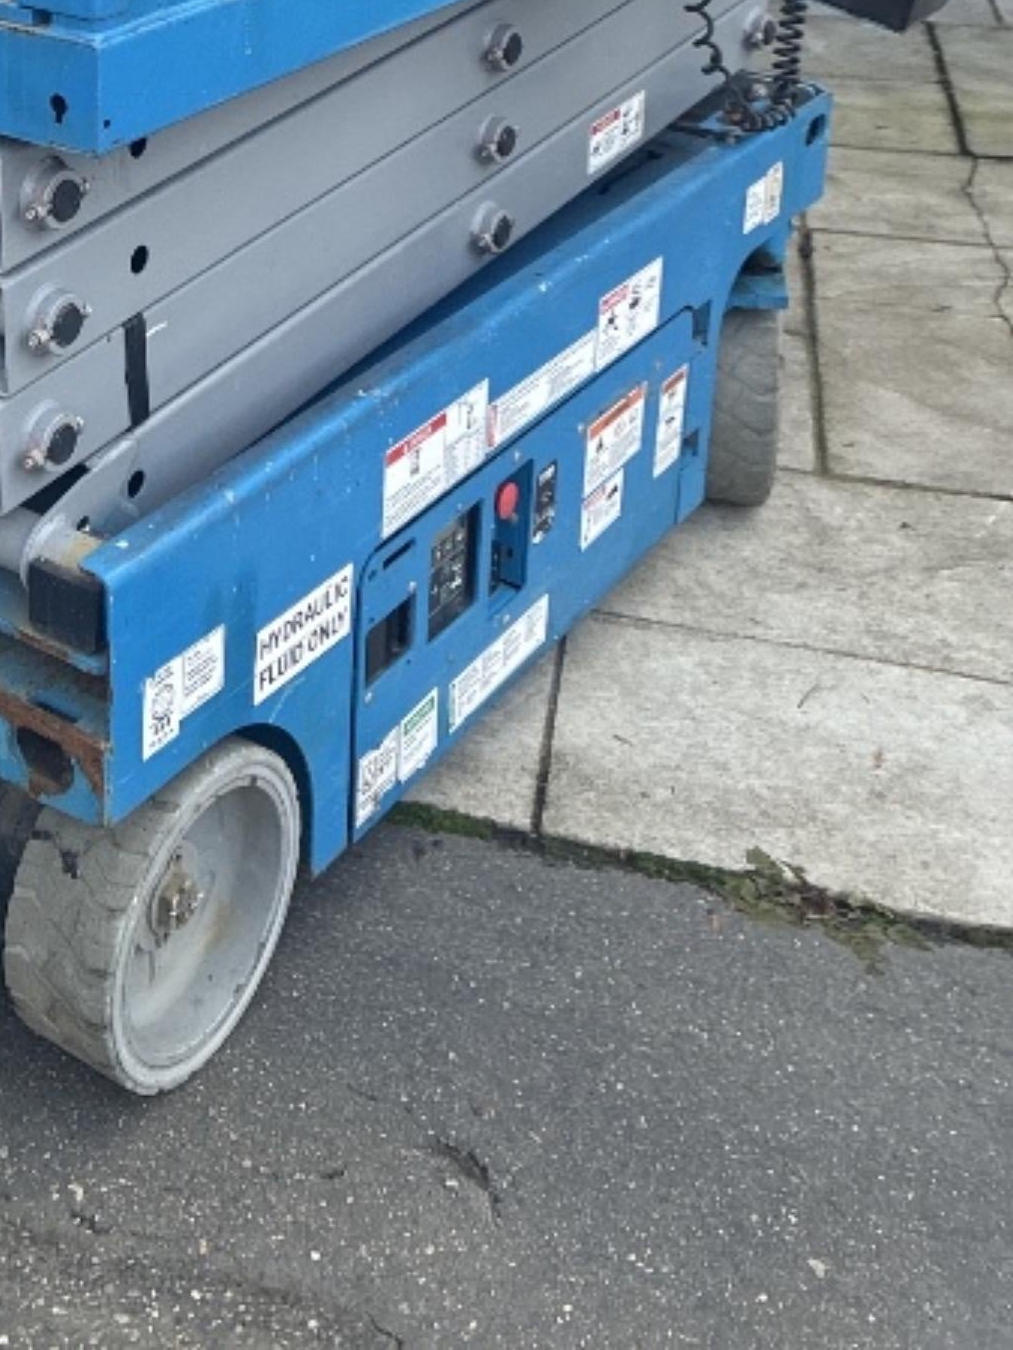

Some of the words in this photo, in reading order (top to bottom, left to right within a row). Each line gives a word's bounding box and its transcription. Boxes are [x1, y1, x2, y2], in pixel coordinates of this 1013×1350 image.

[259, 574, 350, 662] HYDRAULIC
[259, 639, 304, 693] FLUID
[307, 604, 349, 653] ONLY
